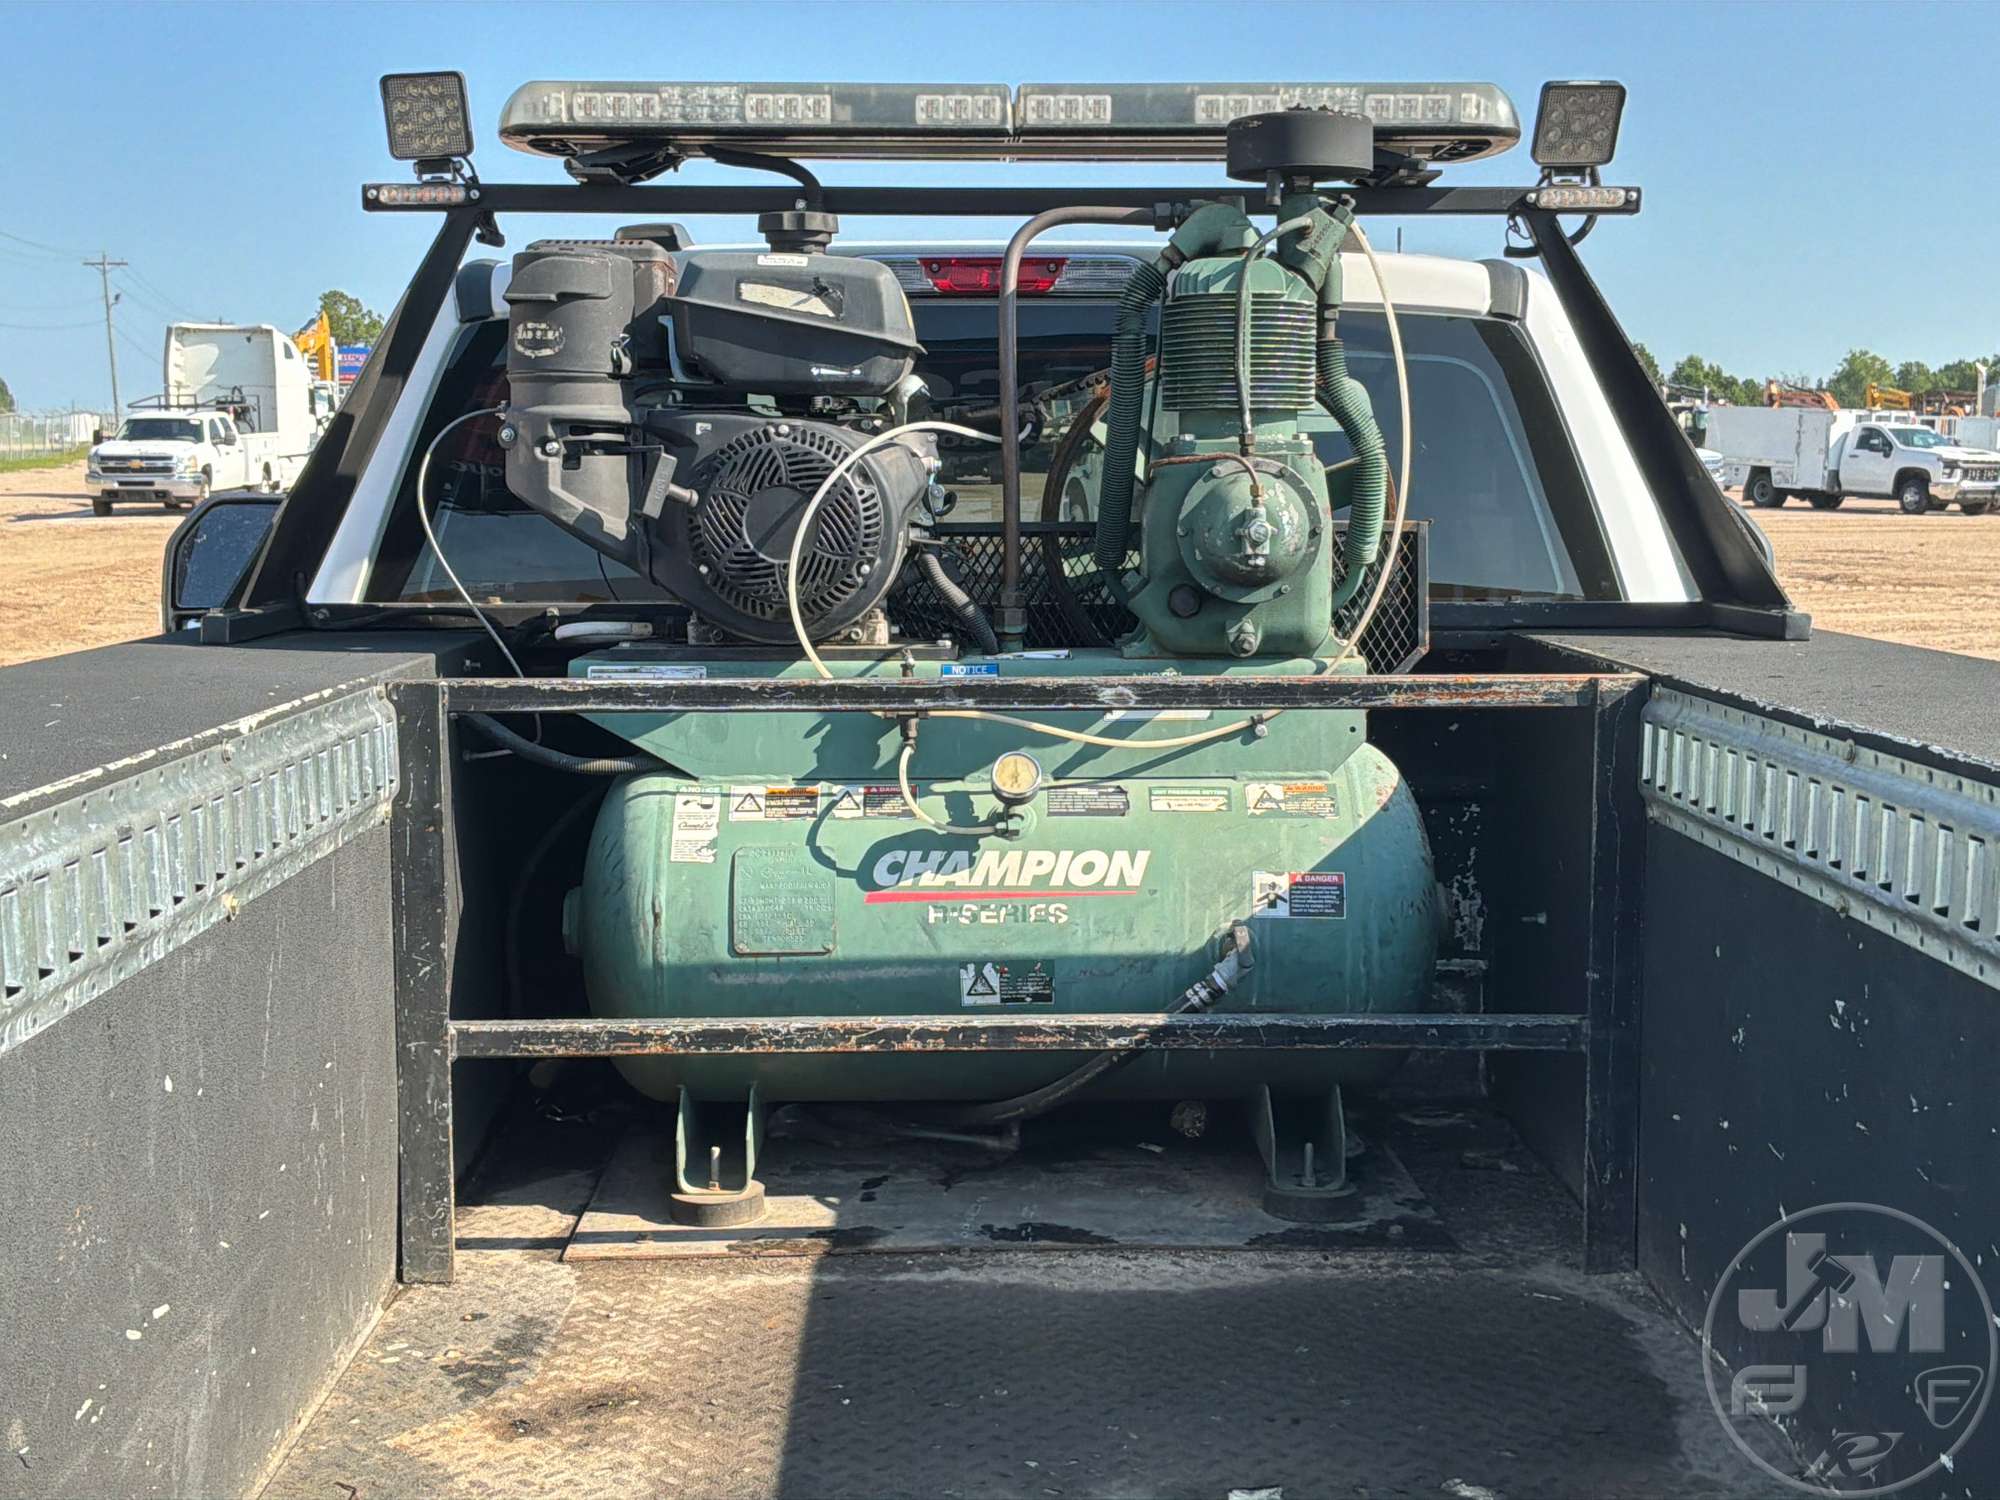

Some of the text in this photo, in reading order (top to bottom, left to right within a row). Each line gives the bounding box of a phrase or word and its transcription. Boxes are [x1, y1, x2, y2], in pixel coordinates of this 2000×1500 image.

[951, 665, 988, 674] NOTICE
[873, 850, 1151, 887] CHAMPION
[1304, 874, 1339, 882] DANGER
[928, 902, 1069, 925] R-SERIES
